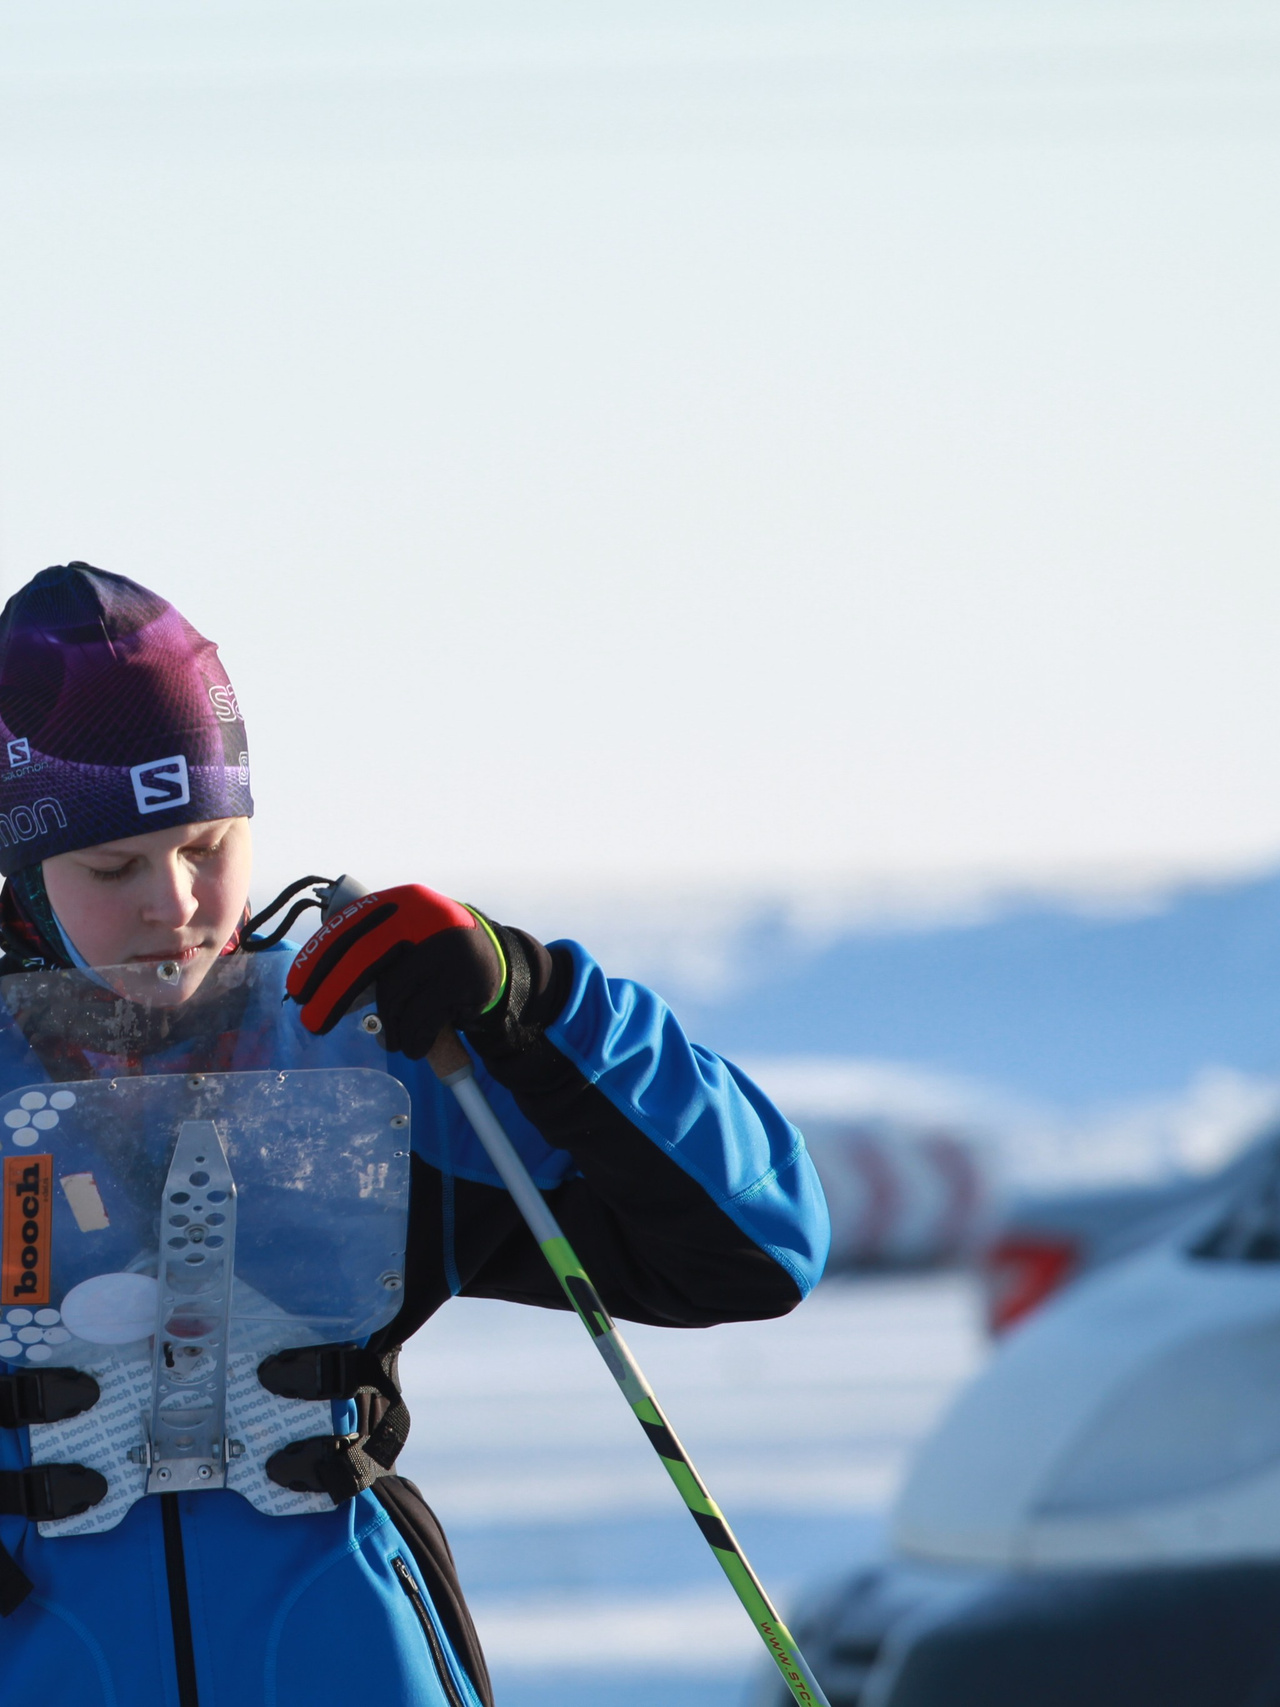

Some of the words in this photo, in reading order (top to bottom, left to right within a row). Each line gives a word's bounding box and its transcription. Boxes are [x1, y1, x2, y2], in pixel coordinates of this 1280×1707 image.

[1, 761, 49, 781] salomon
[295, 895, 379, 968] NORDSKI
[13, 1163, 40, 1297] booch
[100, 1402, 138, 1424] booch
[233, 1394, 271, 1416] booch
[239, 1407, 277, 1430] booch
[245, 1421, 283, 1444] booch
[284, 1405, 322, 1427] booch
[66, 1432, 105, 1454] booch
[111, 1433, 142, 1451] booc
